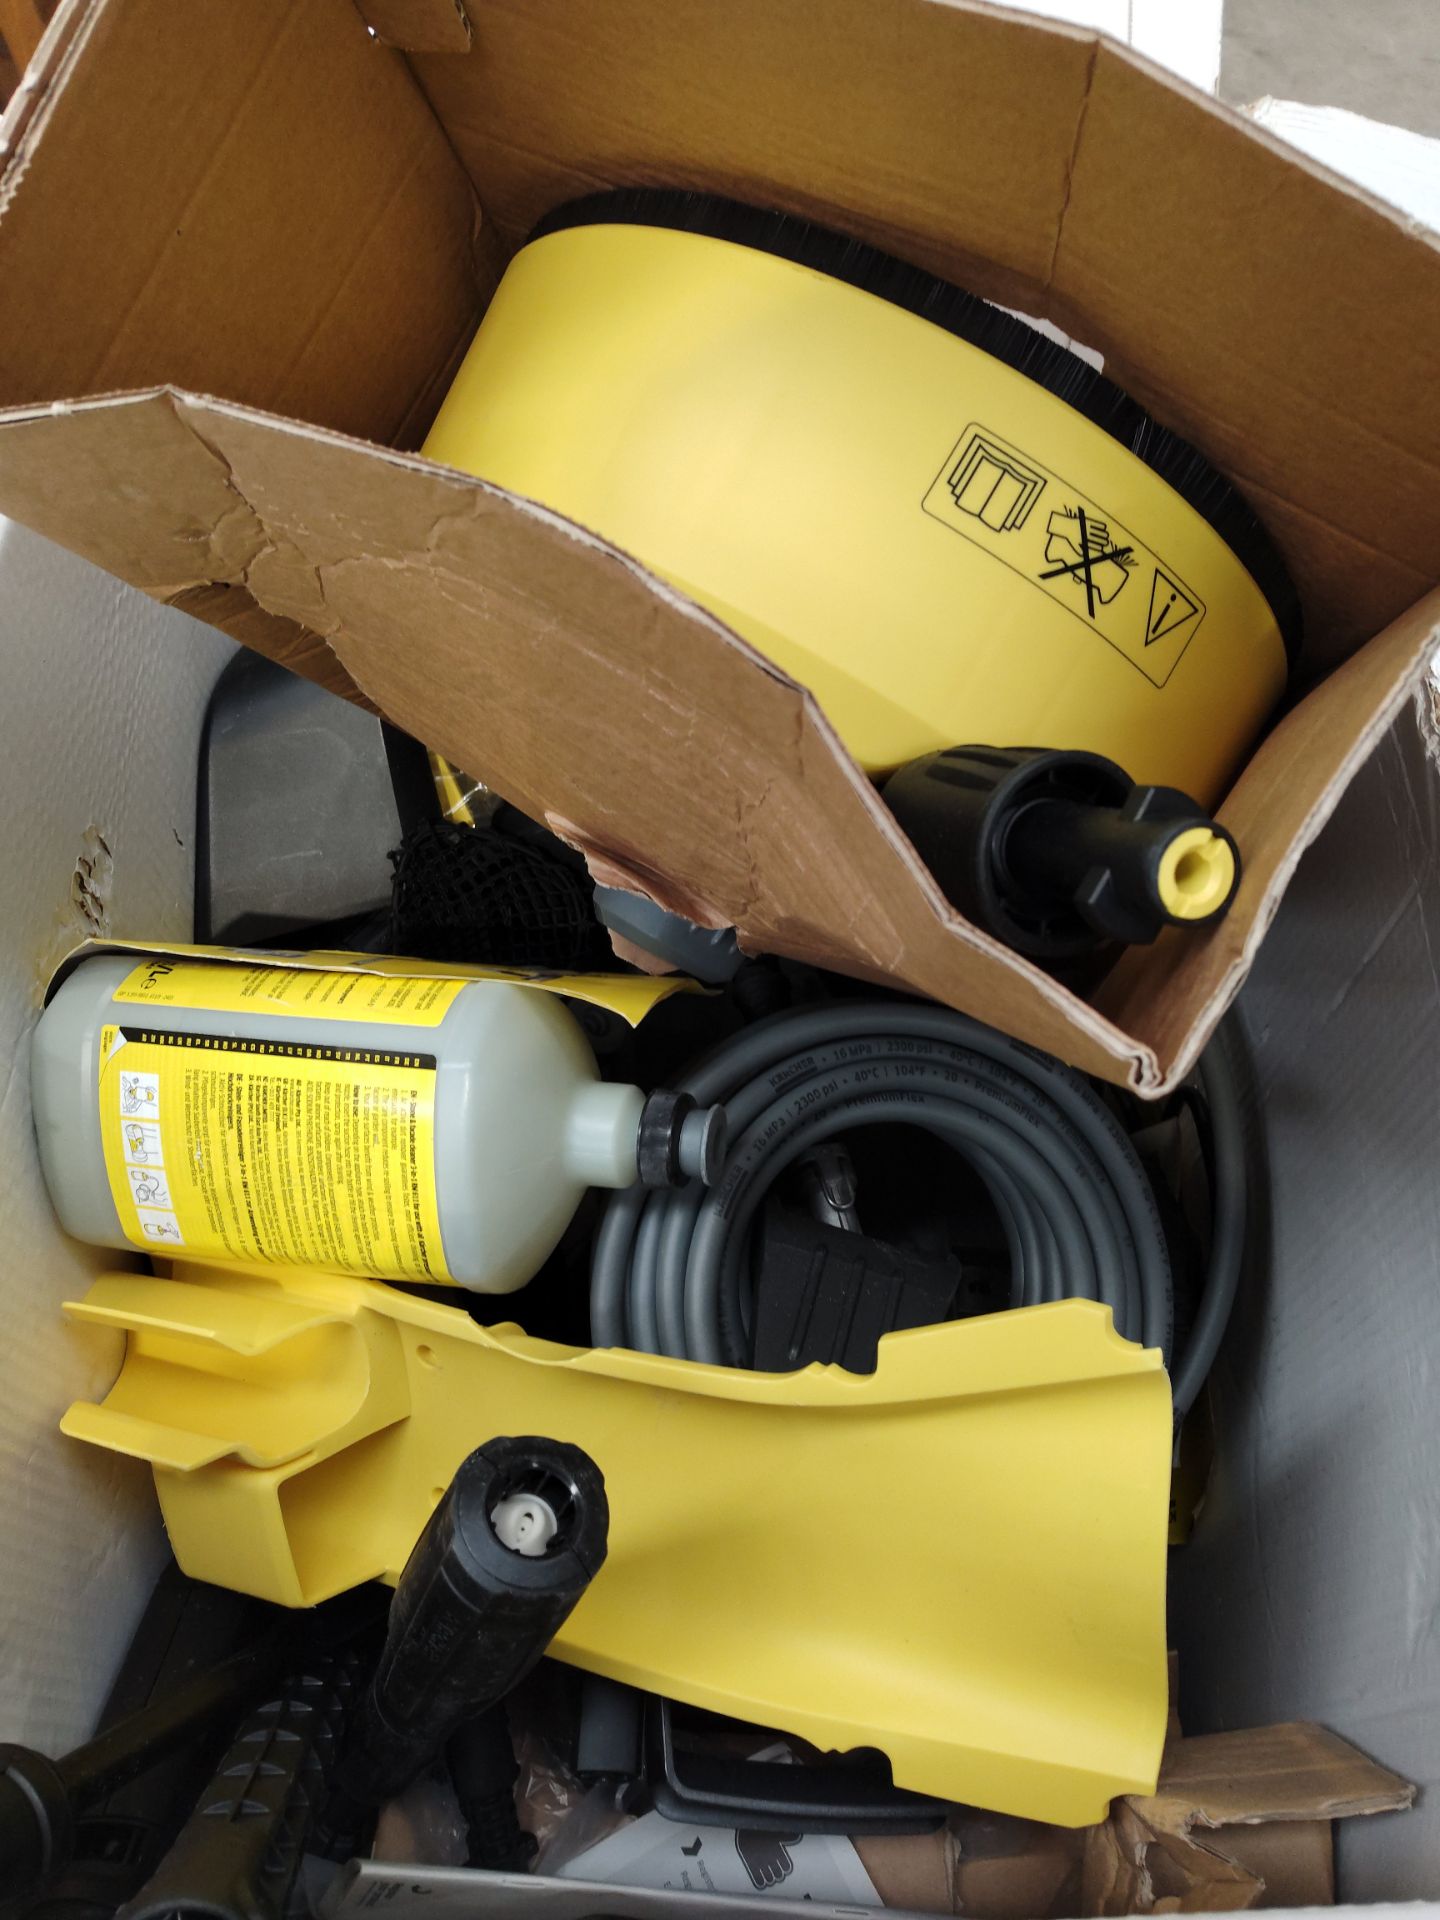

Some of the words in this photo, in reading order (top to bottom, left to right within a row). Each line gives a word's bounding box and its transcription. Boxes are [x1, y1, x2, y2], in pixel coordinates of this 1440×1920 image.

[833, 1047, 848, 1060] 16
[848, 1043, 873, 1056] MPa
[887, 1041, 914, 1053] 2300
[752, 1136, 767, 1153] 16
[764, 1117, 787, 1138] MPa
[794, 1088, 822, 1116] 2300
[822, 1078, 839, 1097] psi
[854, 1067, 880, 1083] 40°C
[894, 1064, 926, 1076] 104°F
[944, 1070, 959, 1083] 20
